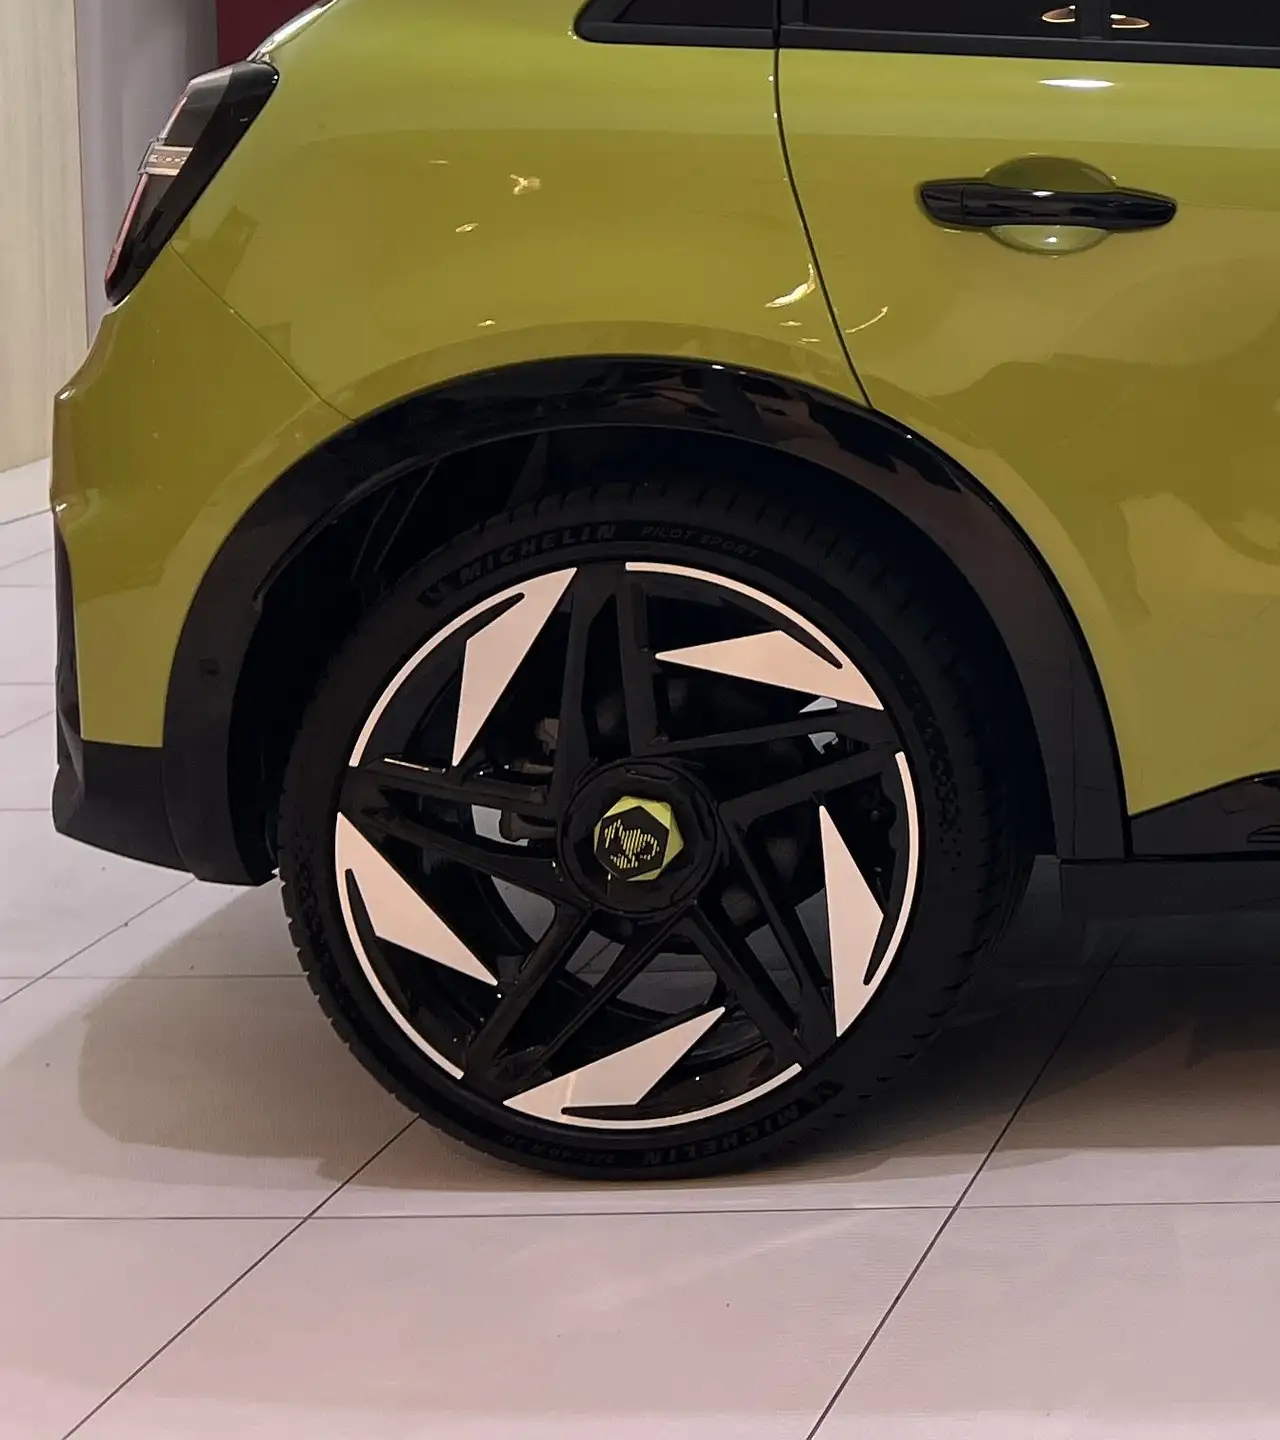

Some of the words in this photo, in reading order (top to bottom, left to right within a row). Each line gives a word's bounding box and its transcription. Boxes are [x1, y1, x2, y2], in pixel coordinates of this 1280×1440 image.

[459, 523, 617, 586] MICHELIN
[641, 524, 696, 544] PILOT
[699, 533, 762, 560] SPORT
[643, 1103, 799, 1166] MICHELIN
